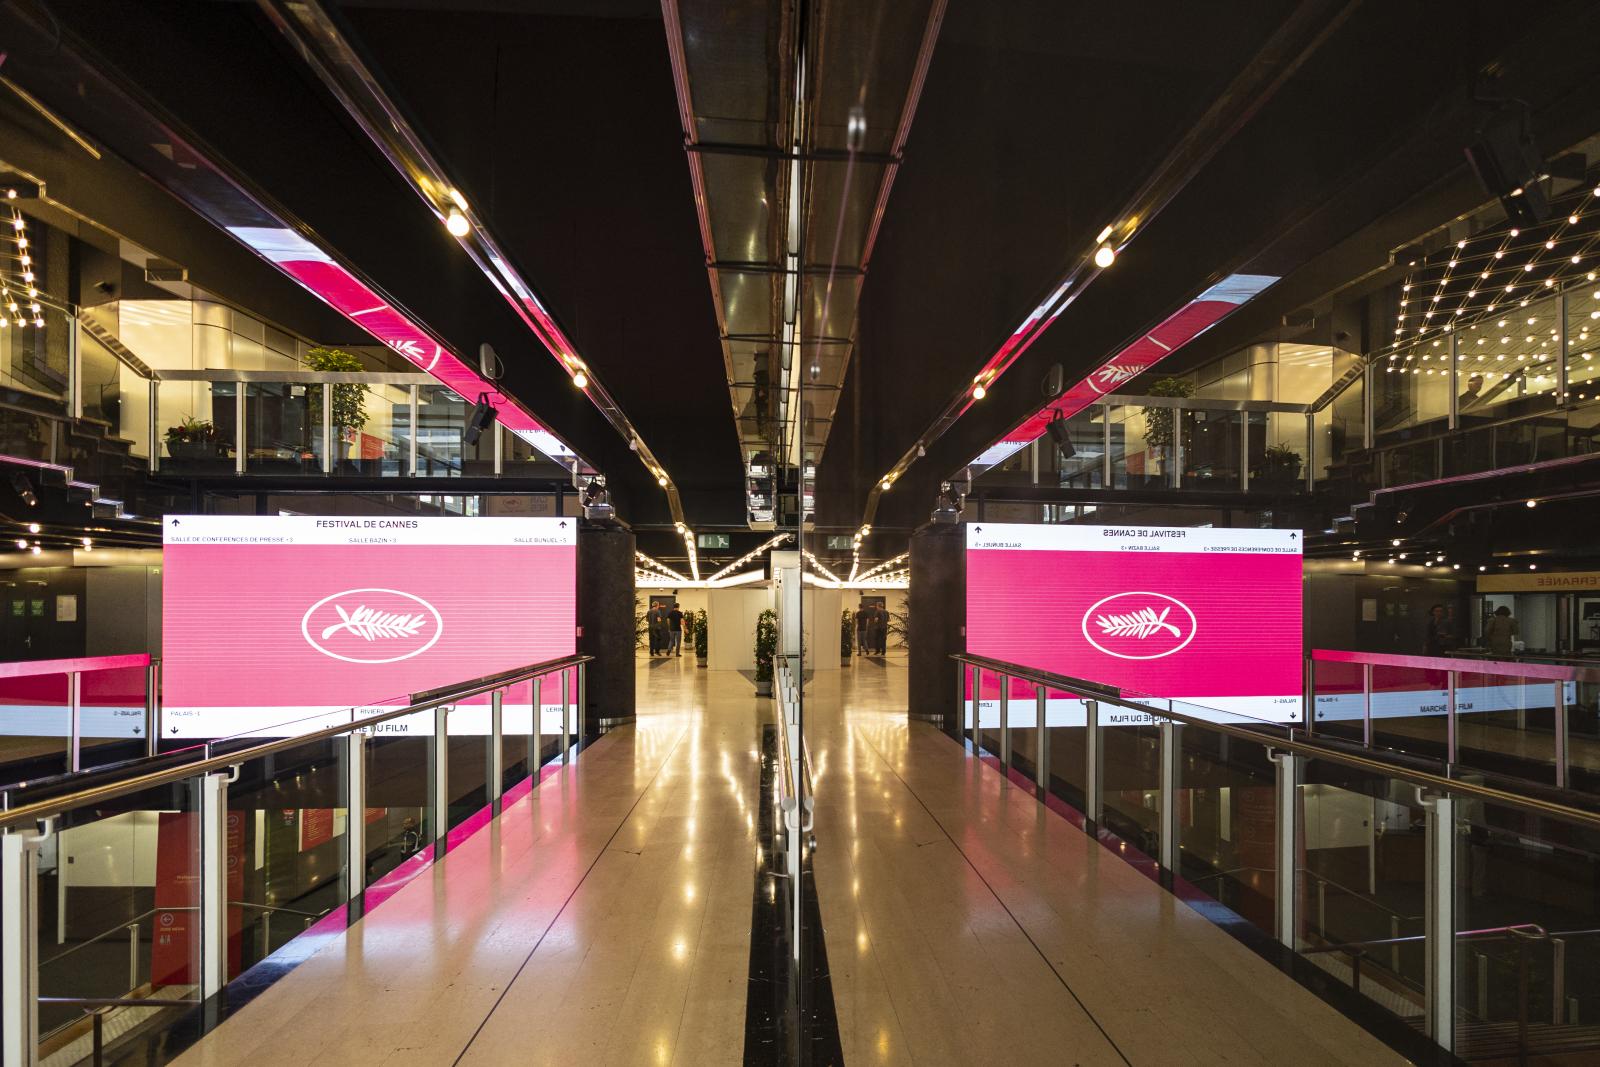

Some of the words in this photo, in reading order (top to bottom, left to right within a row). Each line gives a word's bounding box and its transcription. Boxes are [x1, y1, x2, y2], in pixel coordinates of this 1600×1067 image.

[316, 520, 361, 528] FESTIVAL
[363, 520, 377, 528] DE
[379, 520, 418, 528] CANNES
